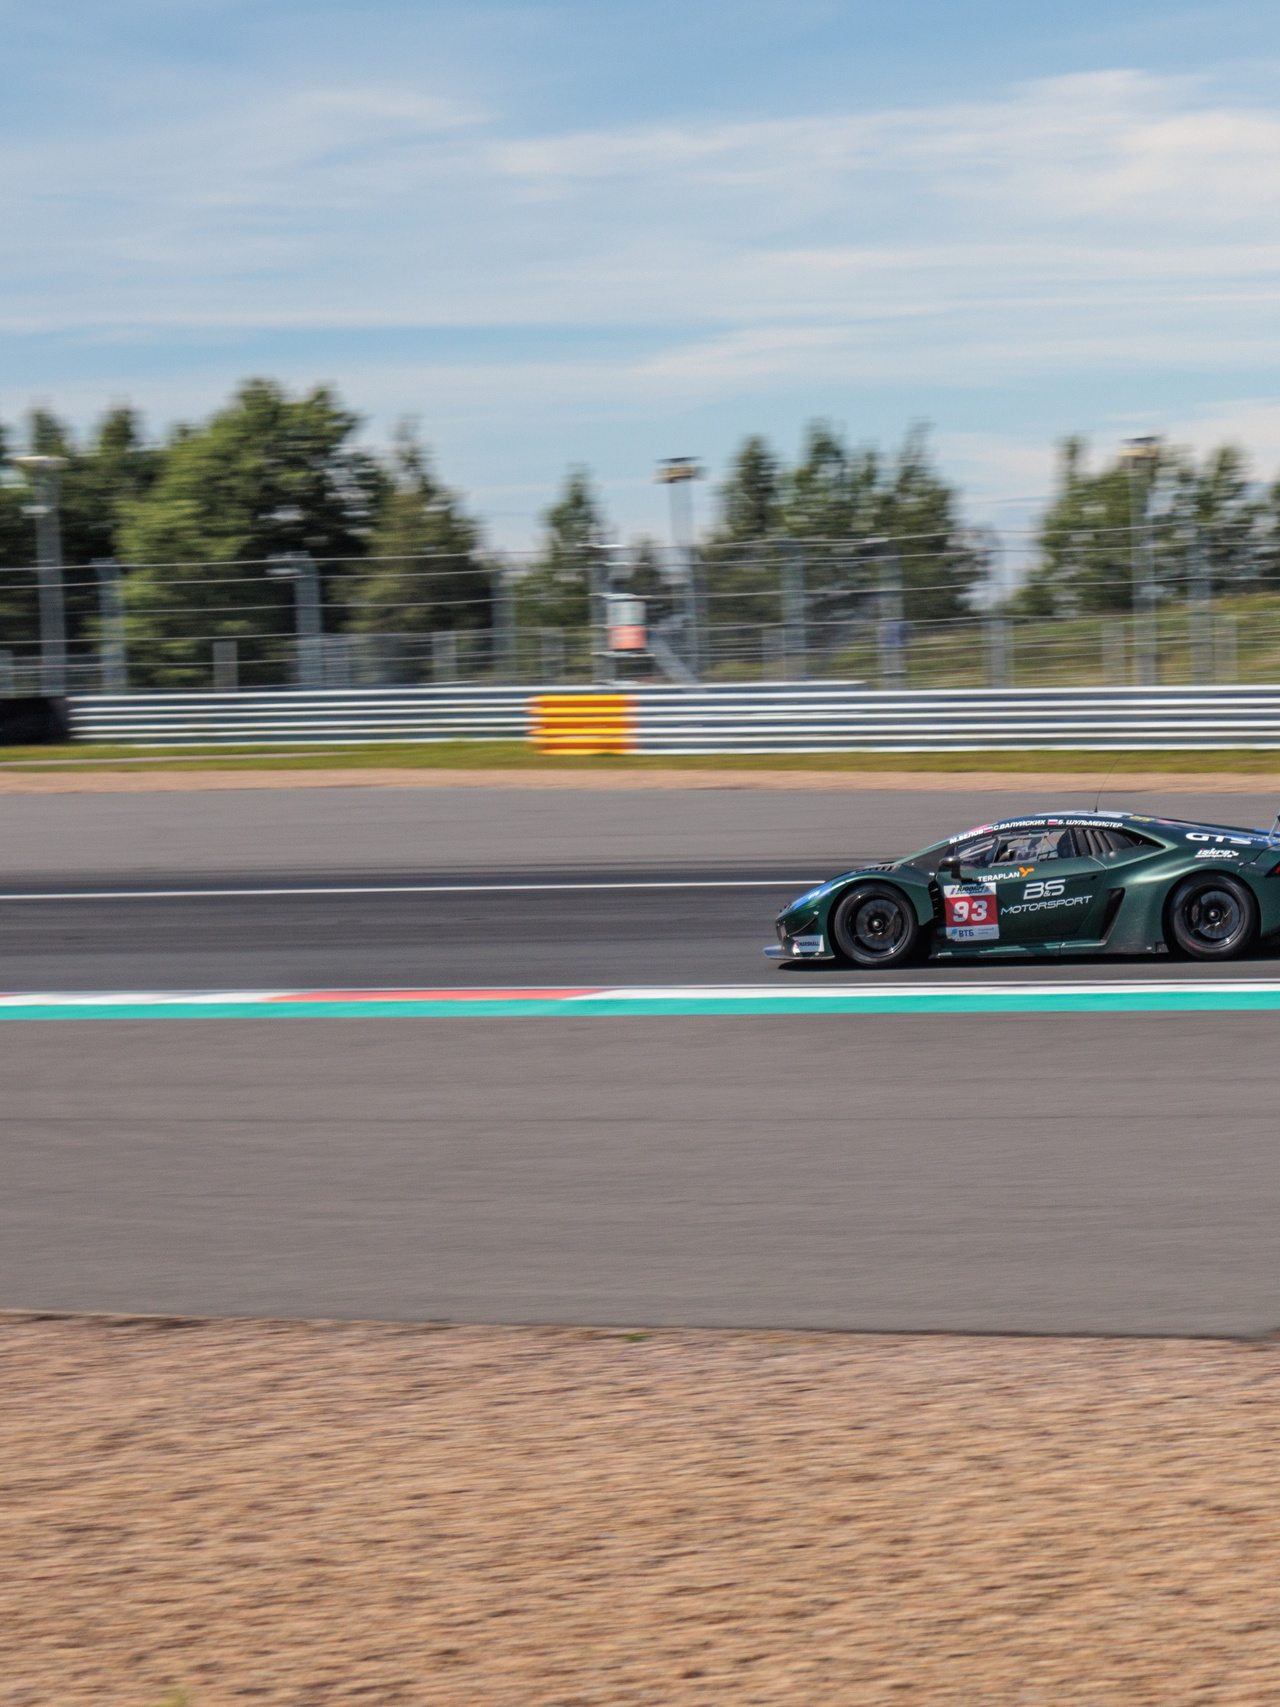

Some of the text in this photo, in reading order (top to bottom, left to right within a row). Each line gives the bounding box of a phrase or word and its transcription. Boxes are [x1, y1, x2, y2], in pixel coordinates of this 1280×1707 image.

[977, 871, 1020, 882] TERAPLAN
[953, 898, 988, 922] 93
[1000, 895, 1093, 915] MOTORSPORT
